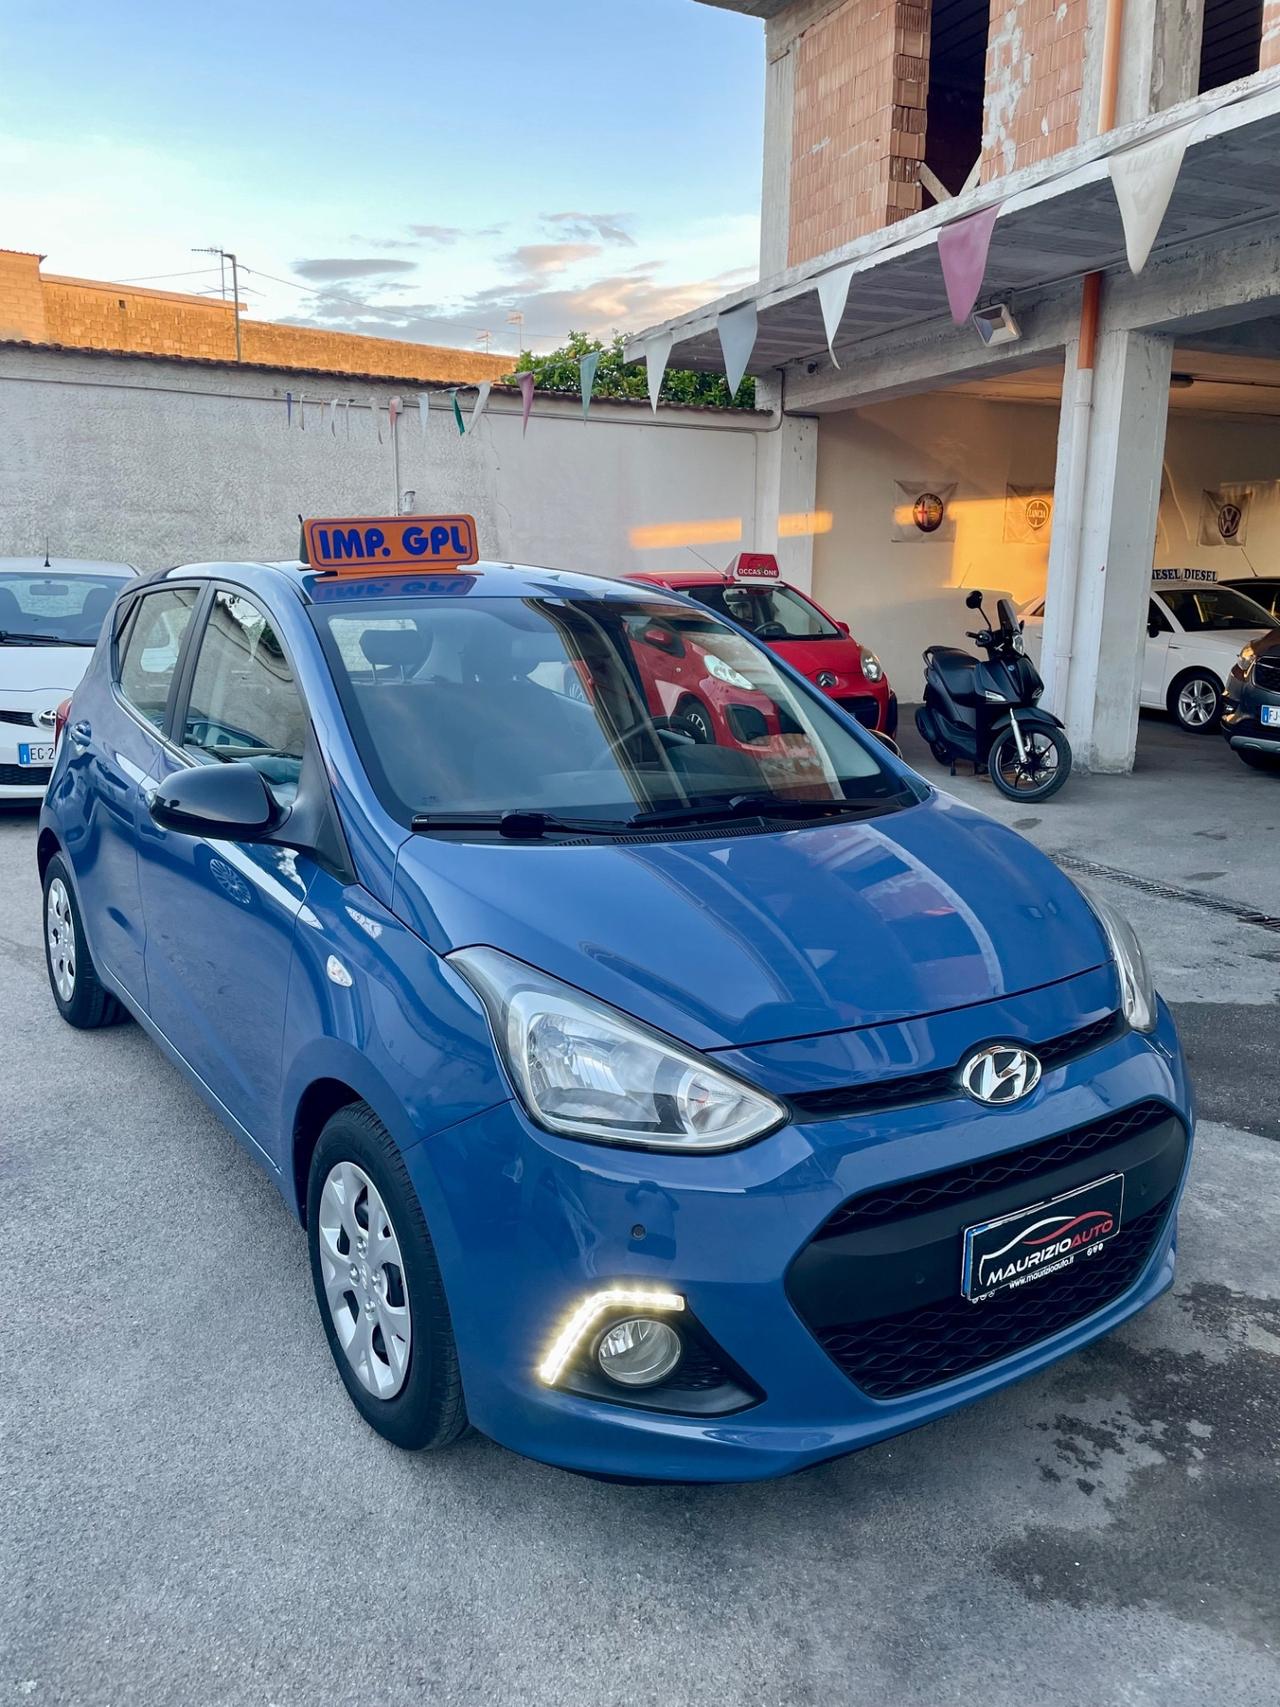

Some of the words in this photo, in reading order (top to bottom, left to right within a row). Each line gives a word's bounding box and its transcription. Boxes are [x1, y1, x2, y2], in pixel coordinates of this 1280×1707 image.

[318, 528, 391, 560] IMP.
[402, 526, 468, 556] GPL
[738, 568, 778, 576] OCCASONE
[1151, 568, 1181, 580] IESEL
[1184, 568, 1218, 582] DIESEL
